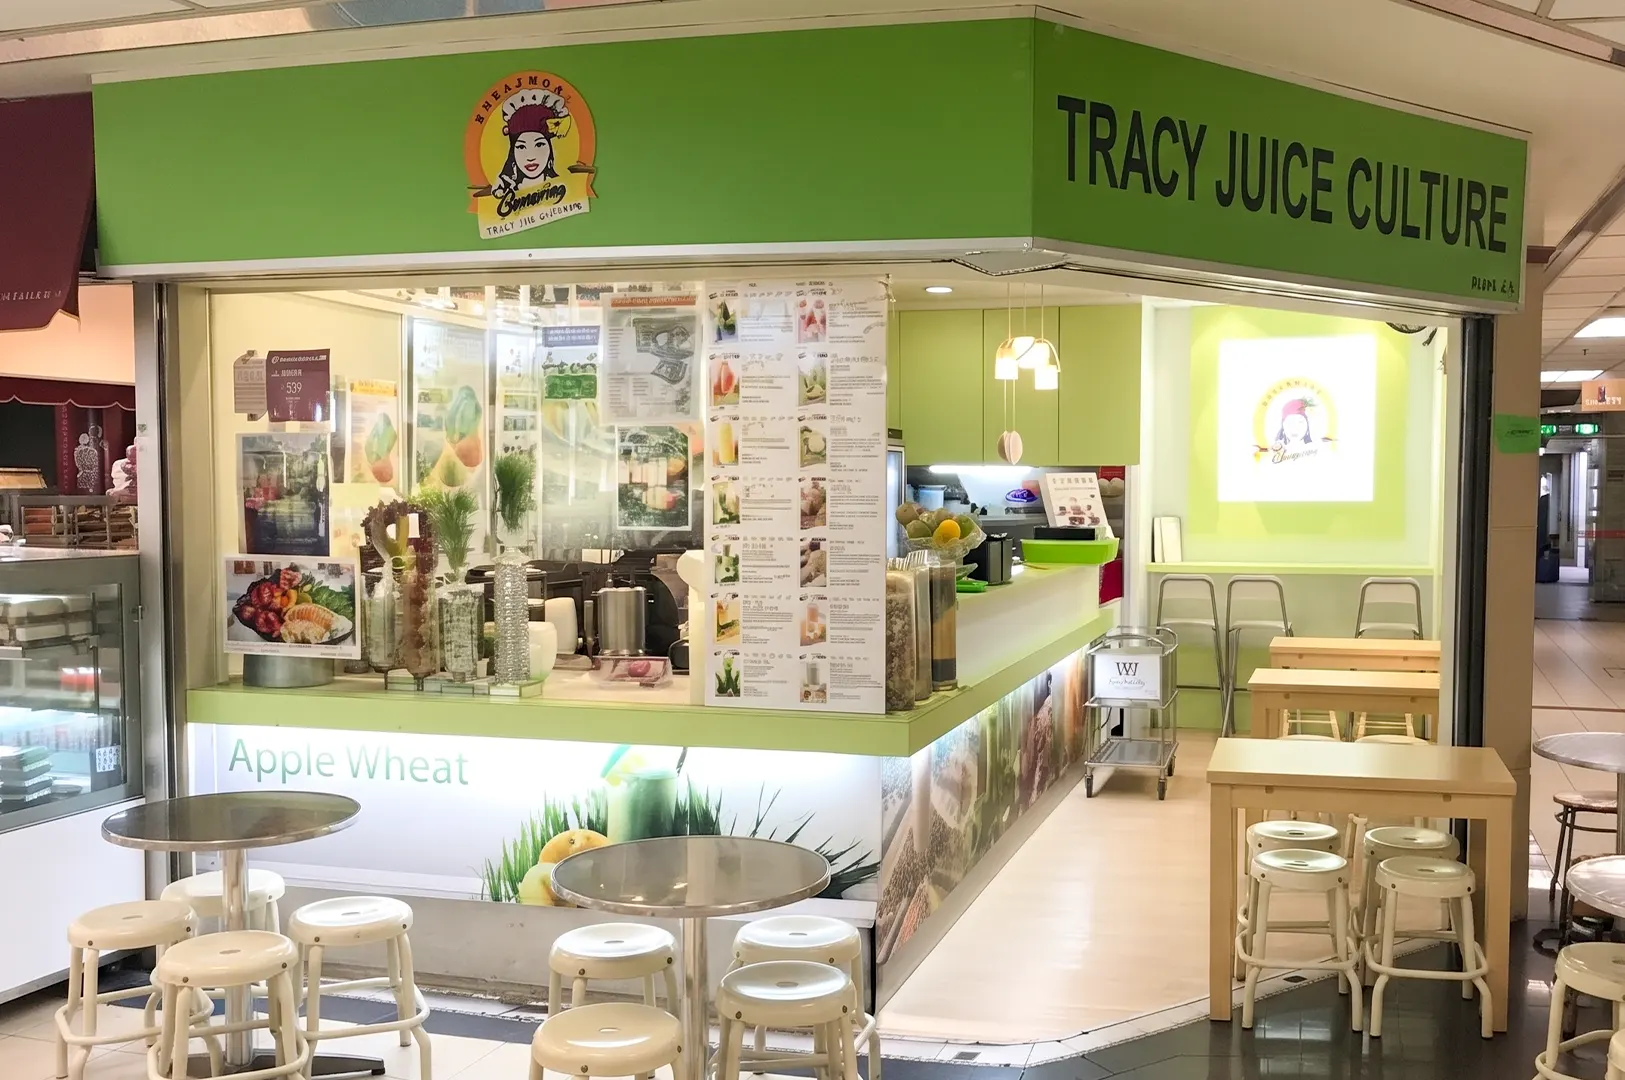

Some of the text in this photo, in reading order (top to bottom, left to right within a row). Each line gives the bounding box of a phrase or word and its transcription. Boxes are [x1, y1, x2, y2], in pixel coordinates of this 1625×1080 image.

[1057, 95, 1508, 253] TRACY JUICE CULTURE
[486, 221, 515, 236] TRACY
[286, 381, 303, 394] 539
[228, 738, 469, 785] Apple Wheat
